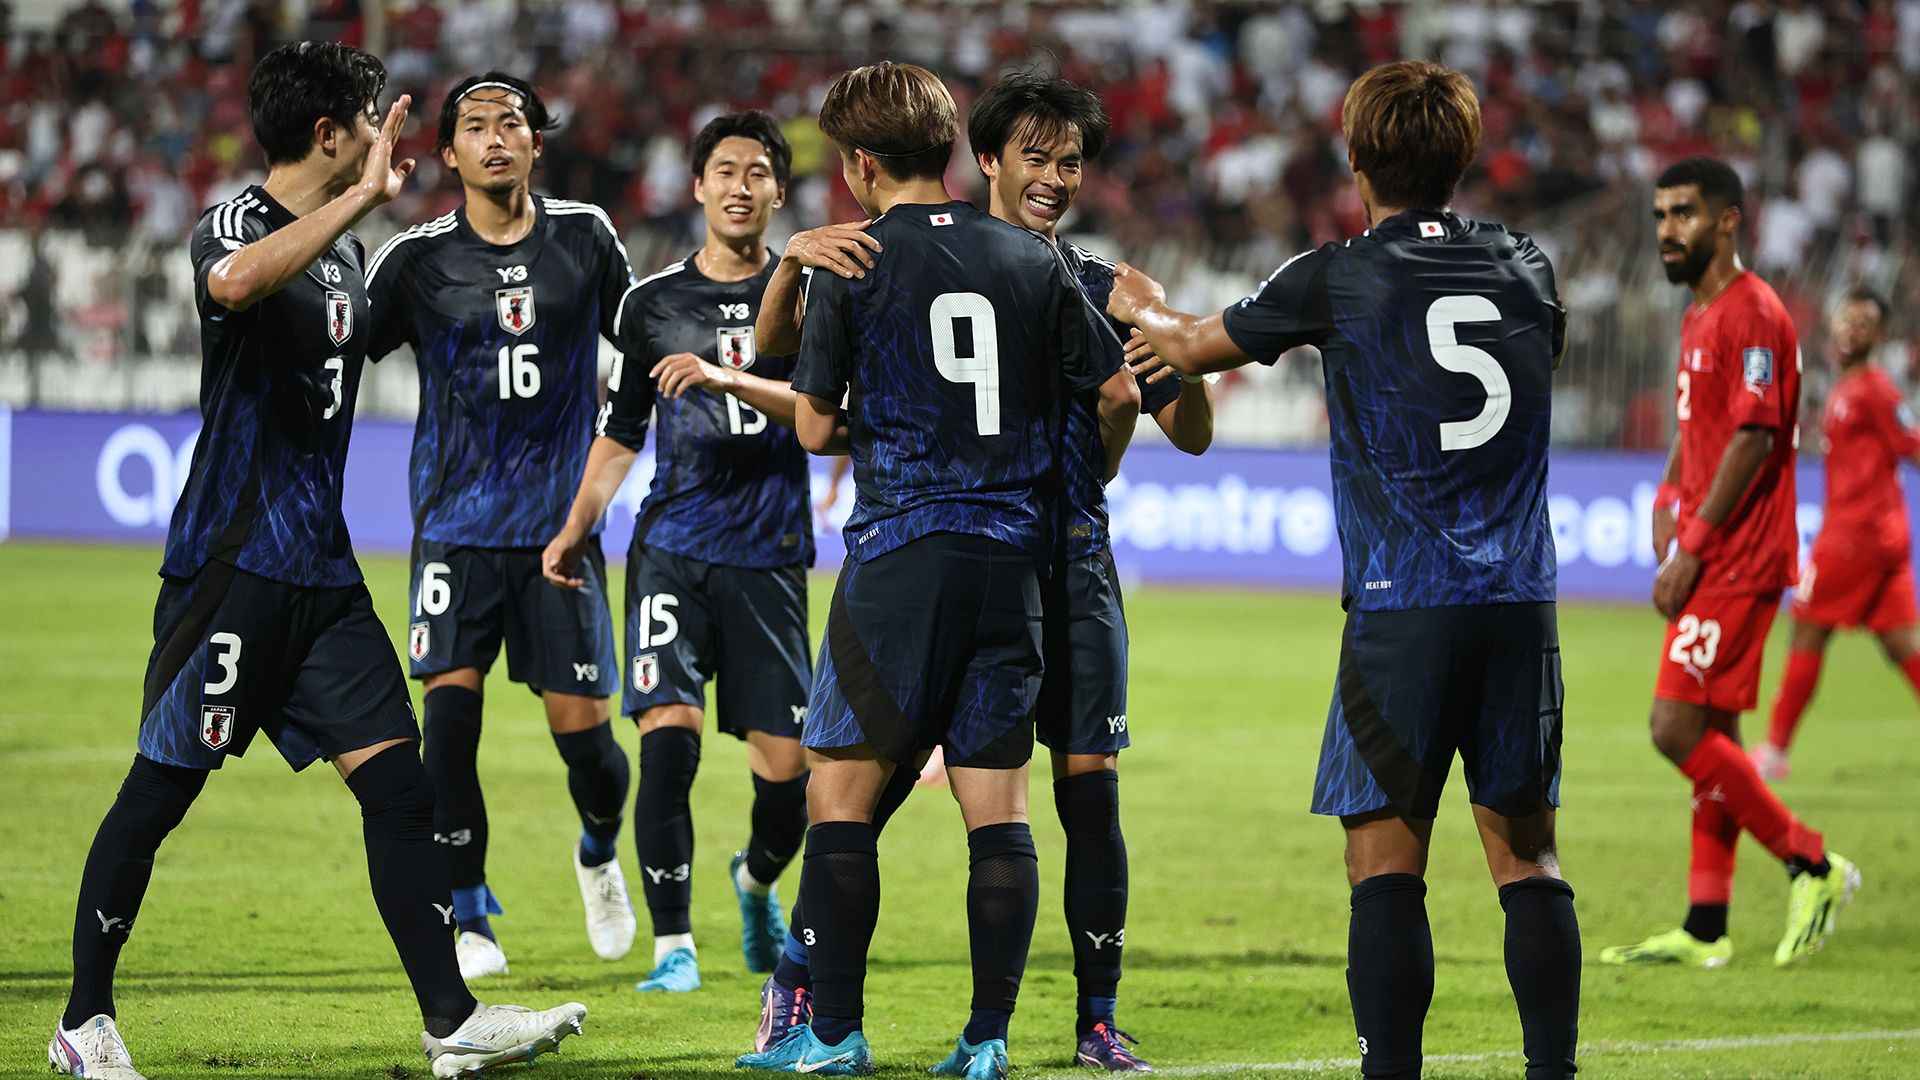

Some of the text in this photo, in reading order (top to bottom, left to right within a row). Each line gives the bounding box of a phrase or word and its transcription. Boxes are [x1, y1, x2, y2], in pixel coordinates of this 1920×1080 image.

[320, 263, 342, 284] Y-3
[496, 264, 528, 284] Y-3
[718, 303, 750, 320] Y-3
[322, 357, 345, 420] 3
[498, 343, 541, 400] 16
[929, 291, 1001, 436] 9
[1425, 294, 1513, 452] 5
[639, 592, 680, 650] 15
[1668, 613, 1722, 670] 23
[204, 631, 242, 695] 3
[1107, 715, 1127, 735] Y-3
[645, 862, 690, 885] Y-3
